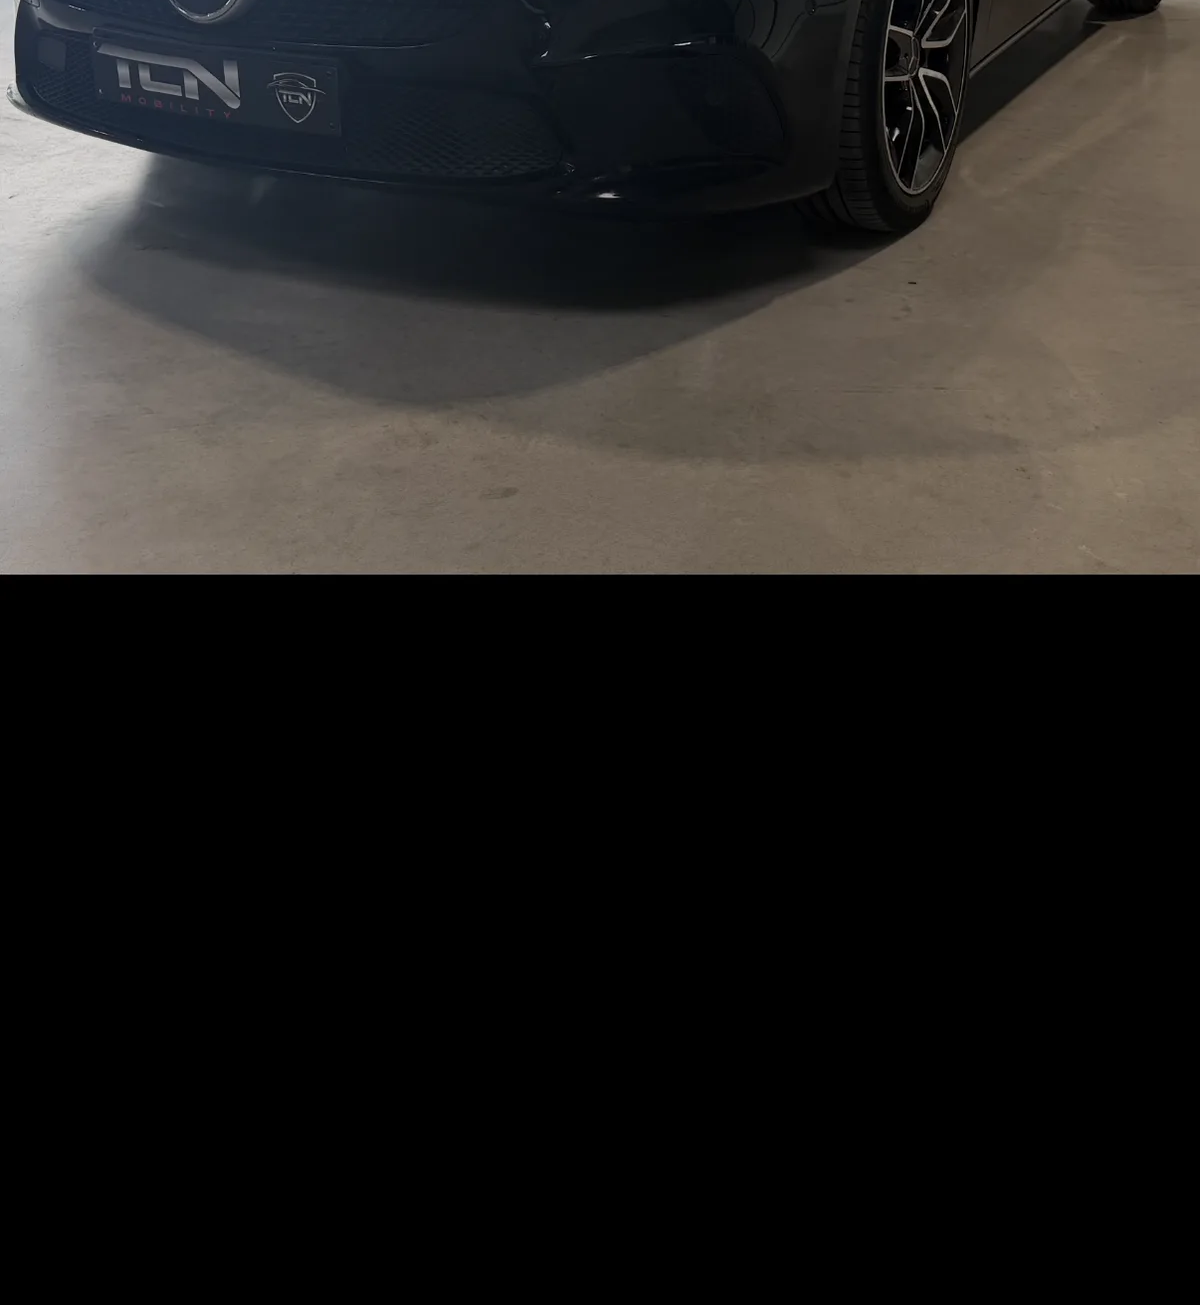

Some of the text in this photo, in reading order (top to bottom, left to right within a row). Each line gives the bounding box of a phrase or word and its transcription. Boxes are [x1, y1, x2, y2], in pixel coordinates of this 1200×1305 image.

[97, 43, 241, 109] TCN
[121, 94, 232, 119] MOBILITY
[278, 90, 311, 106] TCN
